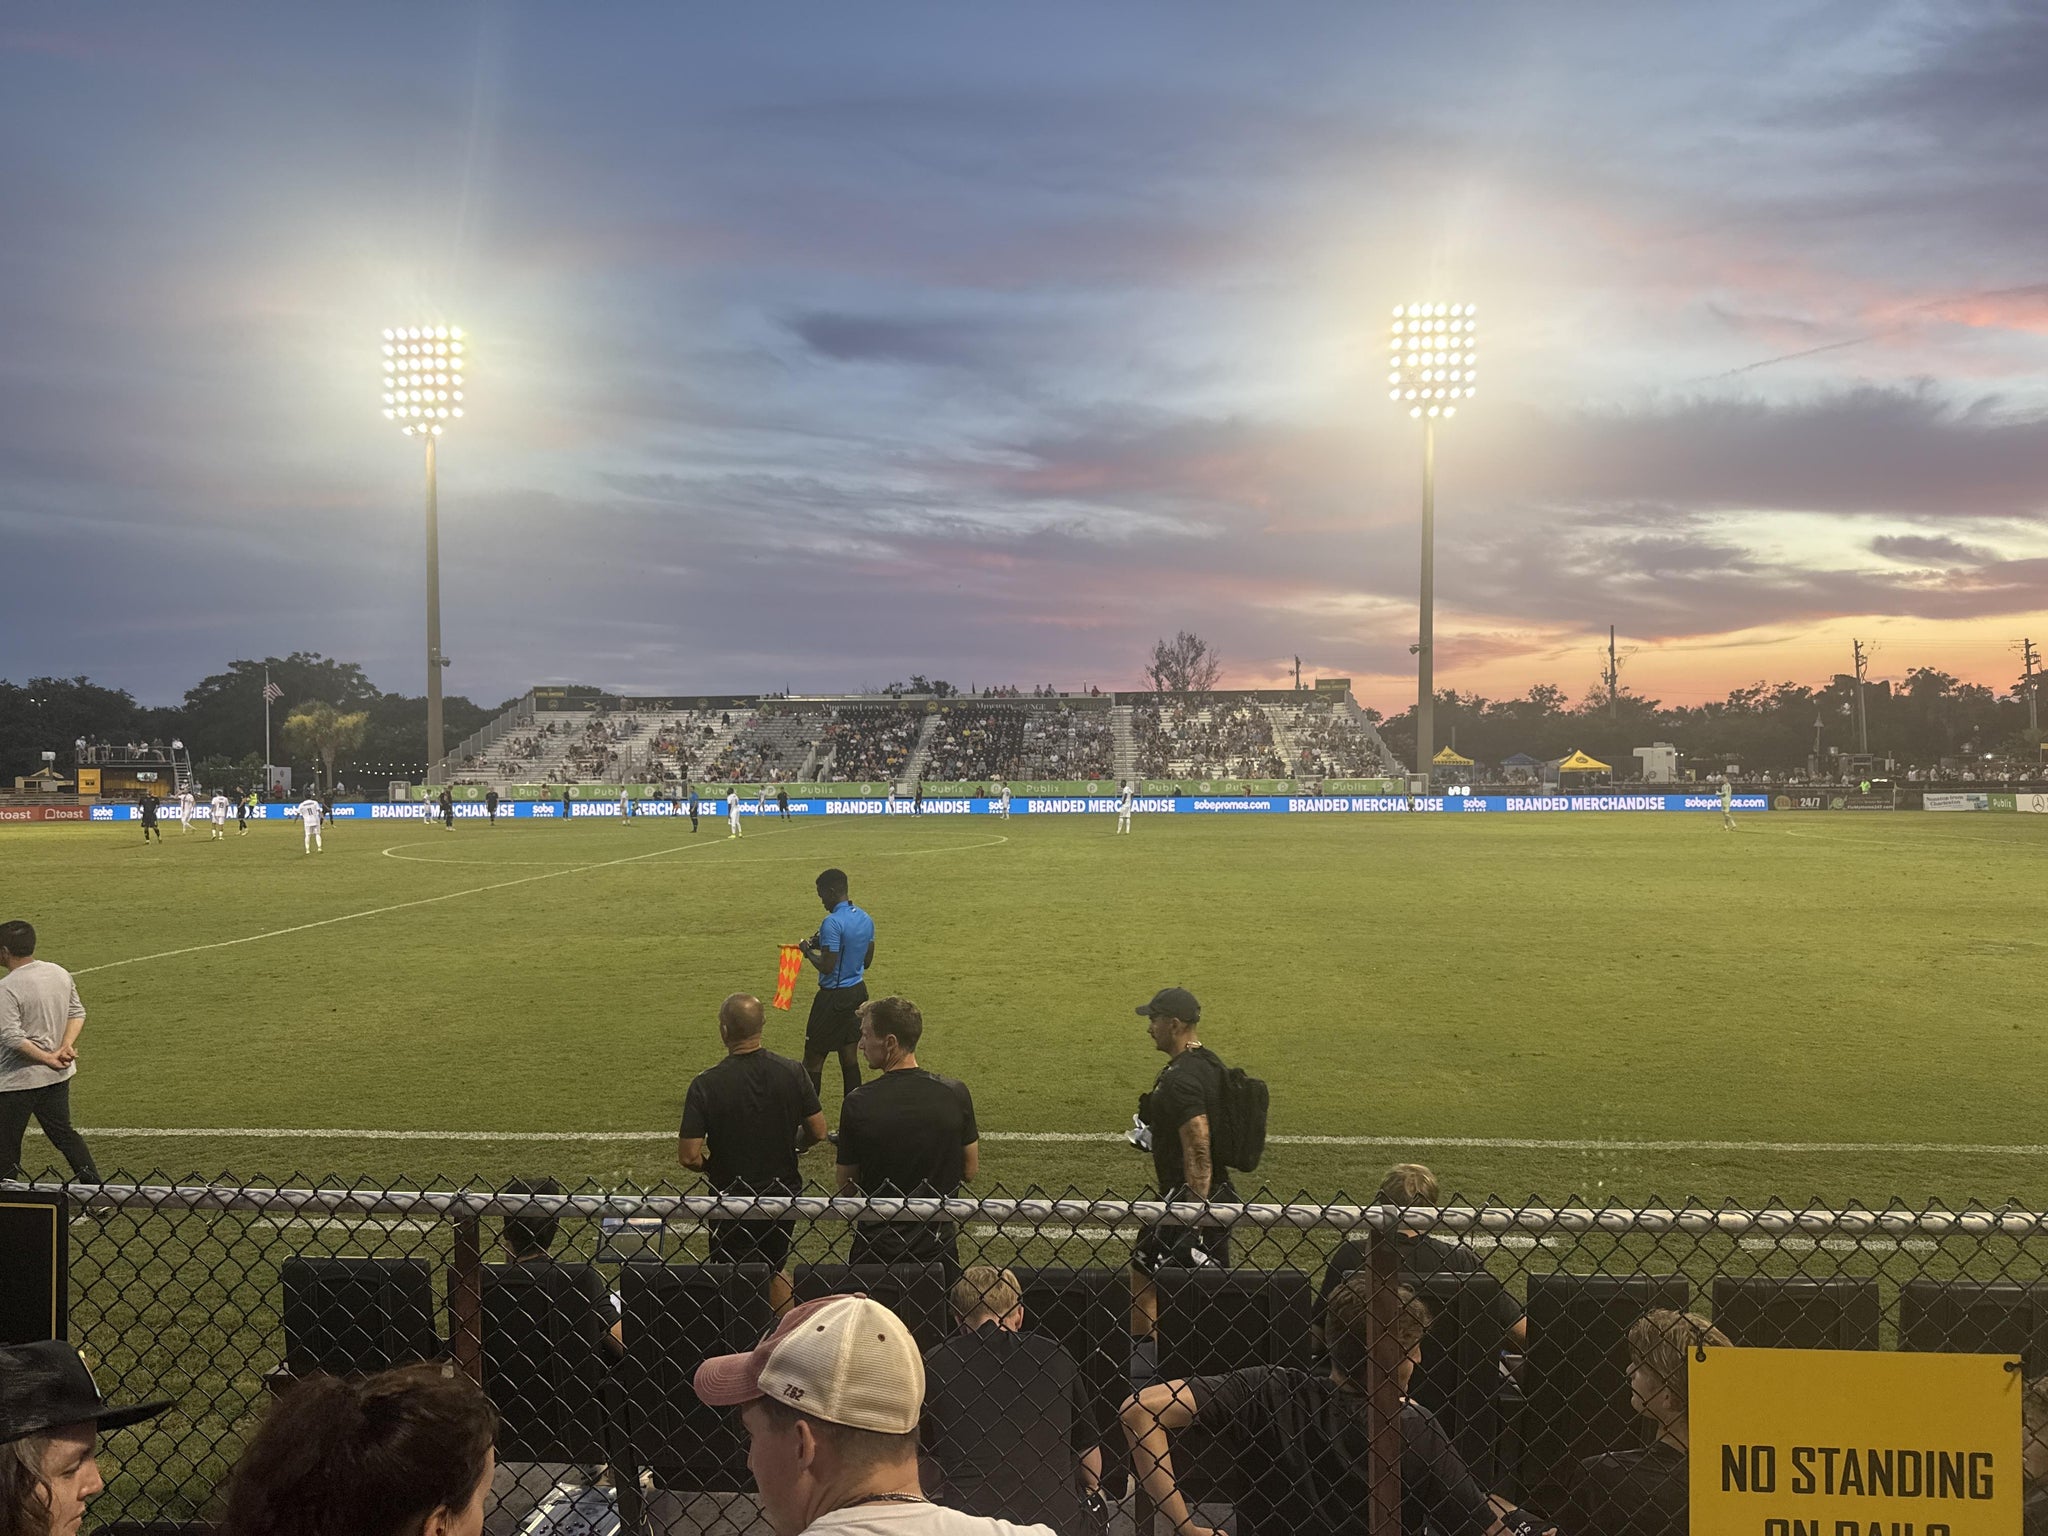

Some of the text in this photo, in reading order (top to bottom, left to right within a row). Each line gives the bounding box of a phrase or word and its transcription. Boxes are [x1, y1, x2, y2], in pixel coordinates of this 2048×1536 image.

[800, 786, 833, 794] Publix
[930, 785, 963, 794] Publix
[1026, 784, 1059, 793] Publix
[1332, 783, 1367, 791] Publix
[826, 801, 883, 813] BRANDED
[1028, 800, 1175, 812] BRANDED MERCANDISE
[1194, 800, 1270, 812] sobepromos.com
[1289, 799, 1349, 812] BRANDED
[1463, 798, 1487, 808] sobe
[1506, 797, 1665, 811] BRANDED MERCHANDISE
[1685, 796, 1765, 810] sobeproos.com
[1800, 797, 1820, 807] 24/7
[1993, 798, 2012, 808] Publix
[55, 808, 83, 819] toast
[93, 806, 113, 817] sobe
[130, 806, 182, 819] BNDED
[533, 804, 554, 813] sobe
[572, 803, 629, 816] BRANDE
[1721, 1444, 1994, 1500] NO STANDING
